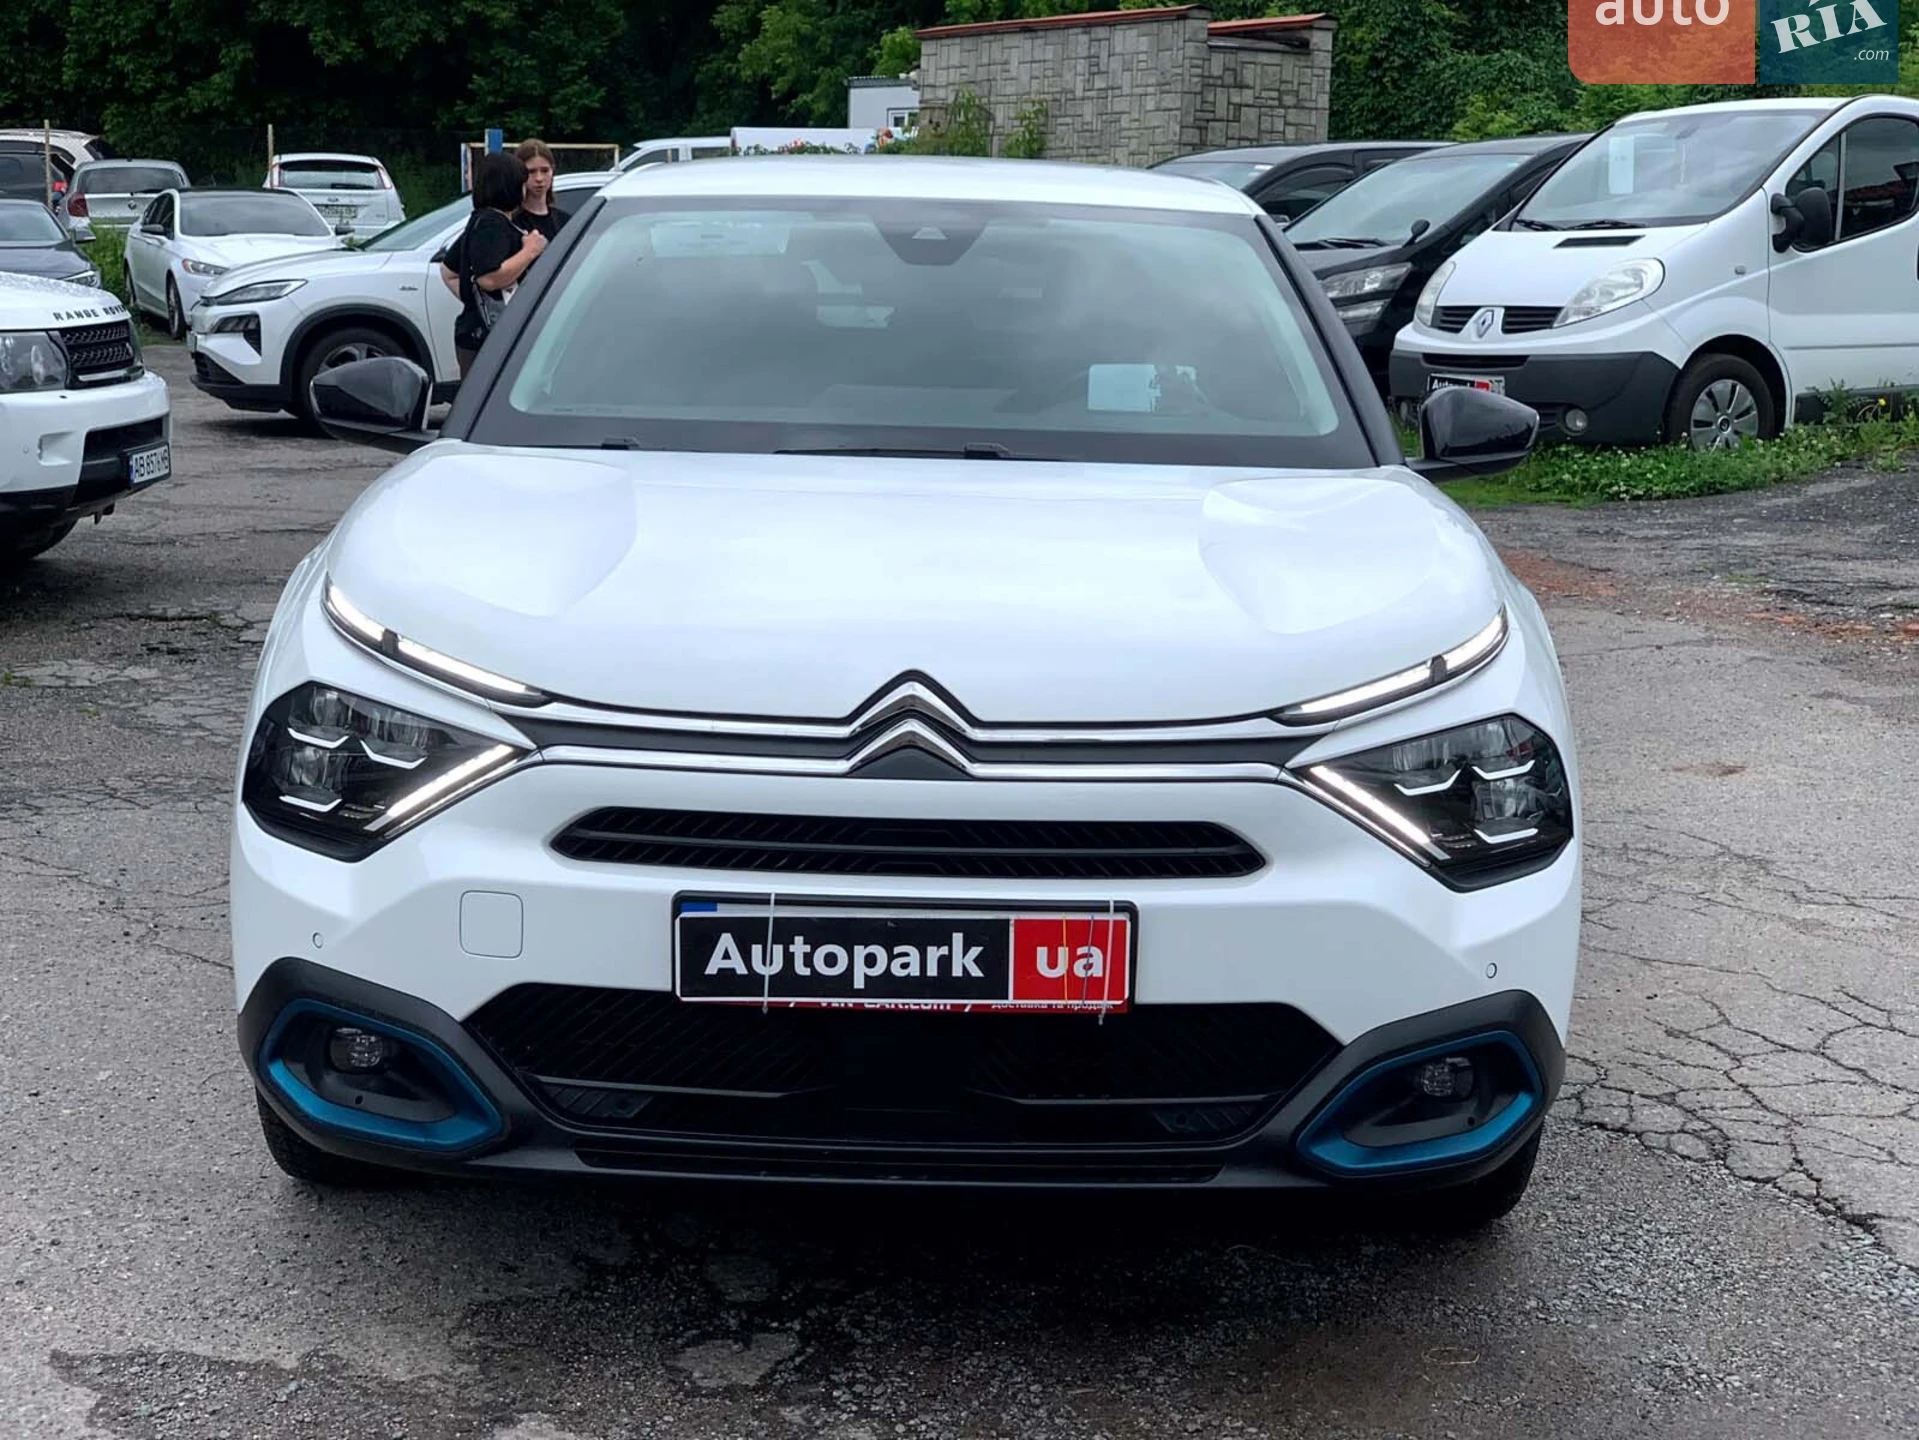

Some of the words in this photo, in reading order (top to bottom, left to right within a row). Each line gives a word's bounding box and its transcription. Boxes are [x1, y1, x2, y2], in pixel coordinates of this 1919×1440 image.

[52, 308, 100, 321] RANGE
[704, 931, 986, 990] Autopark
[1036, 943, 1105, 979] ua
